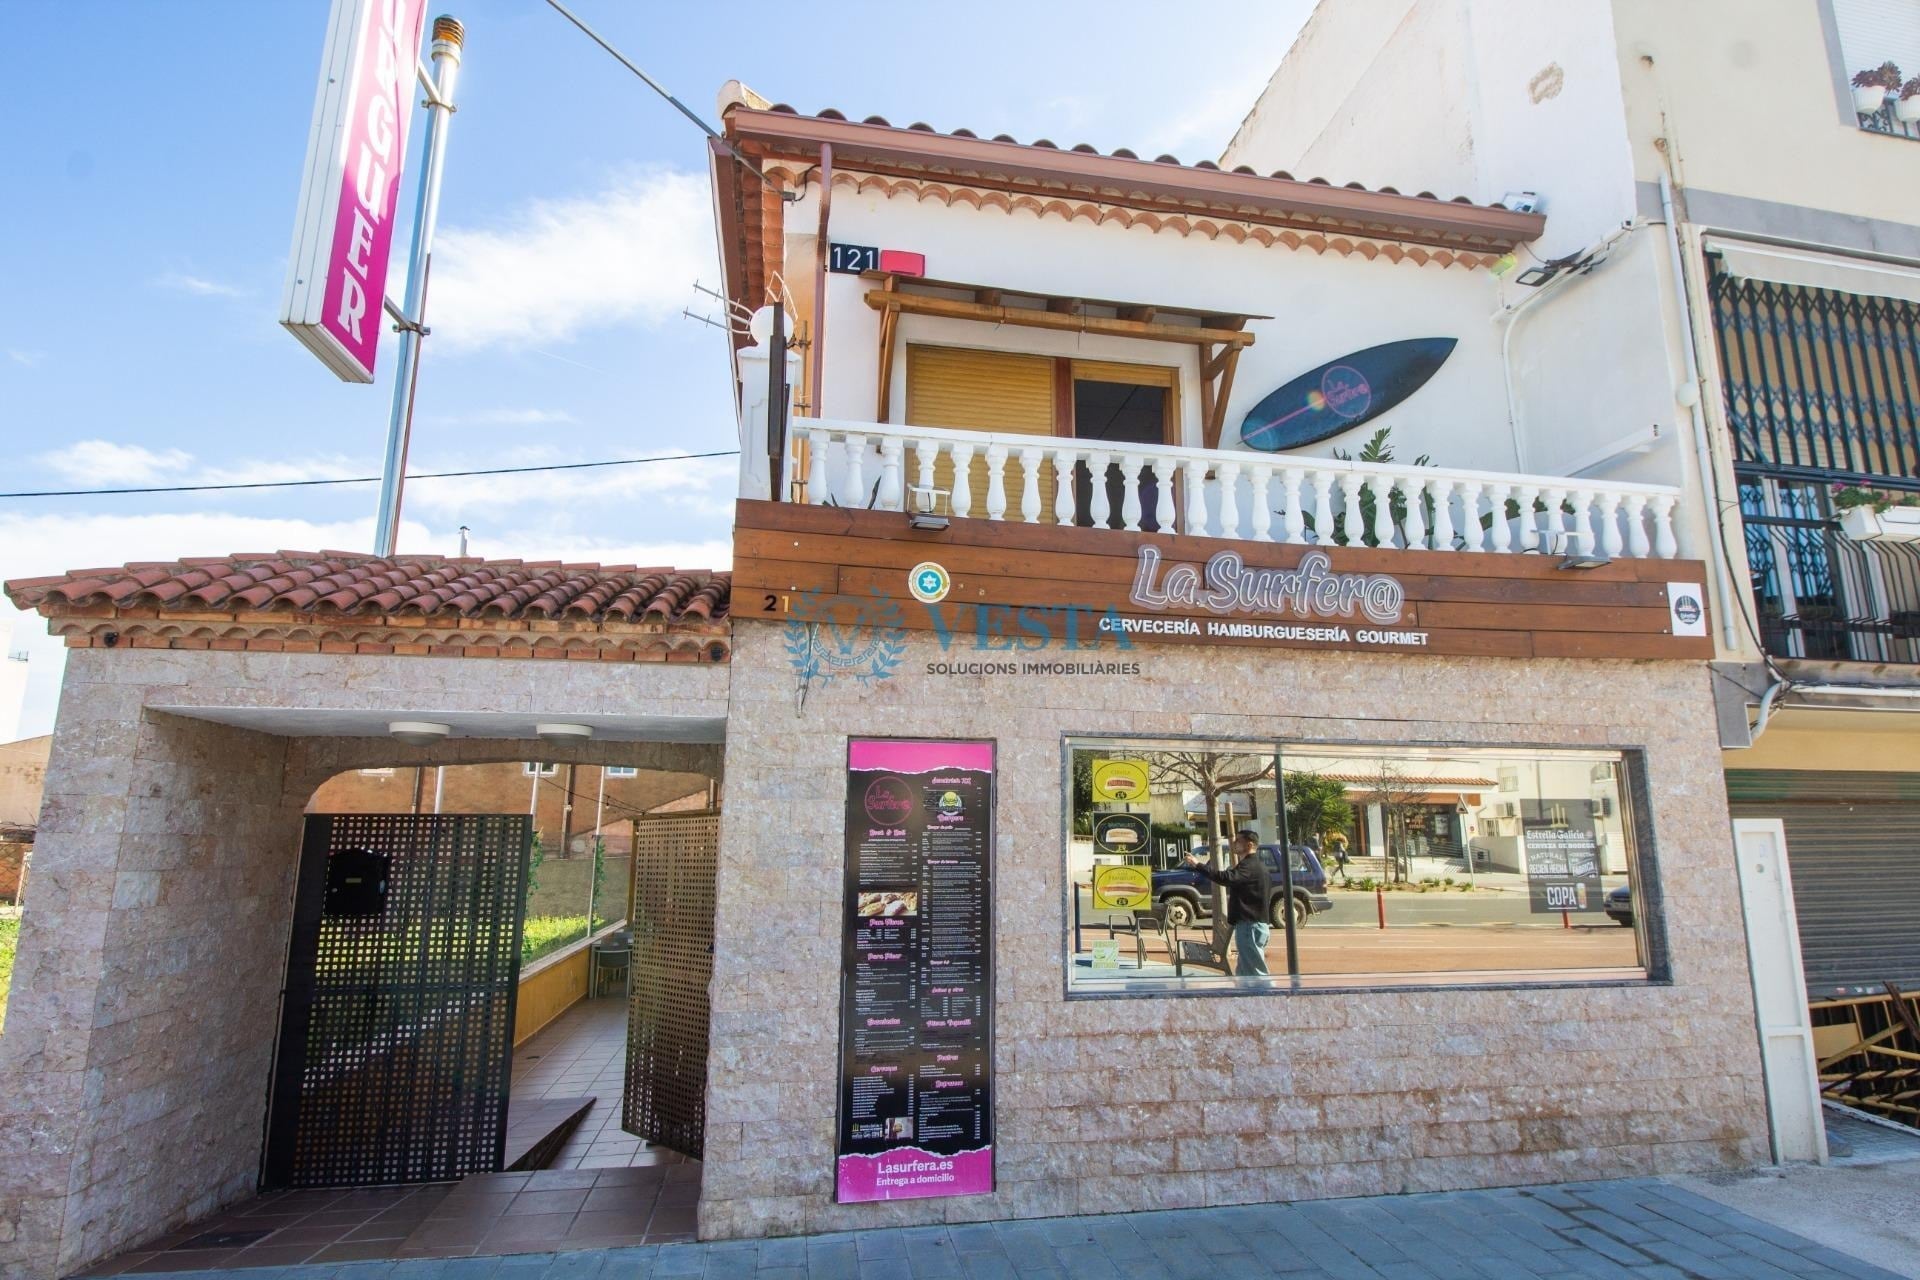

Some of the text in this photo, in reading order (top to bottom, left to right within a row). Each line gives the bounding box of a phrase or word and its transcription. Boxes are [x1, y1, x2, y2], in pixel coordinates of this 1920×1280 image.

[834, 247, 874, 270] 121
[1099, 617, 1428, 645] CERVECERÍA HAMBURGUESERÍA GOURMET
[1547, 887, 1576, 905] COPA
[877, 1160, 954, 1174] Lasurfera.es
[876, 1177, 909, 1187] Entrega
[916, 1173, 954, 1183] domicilio
